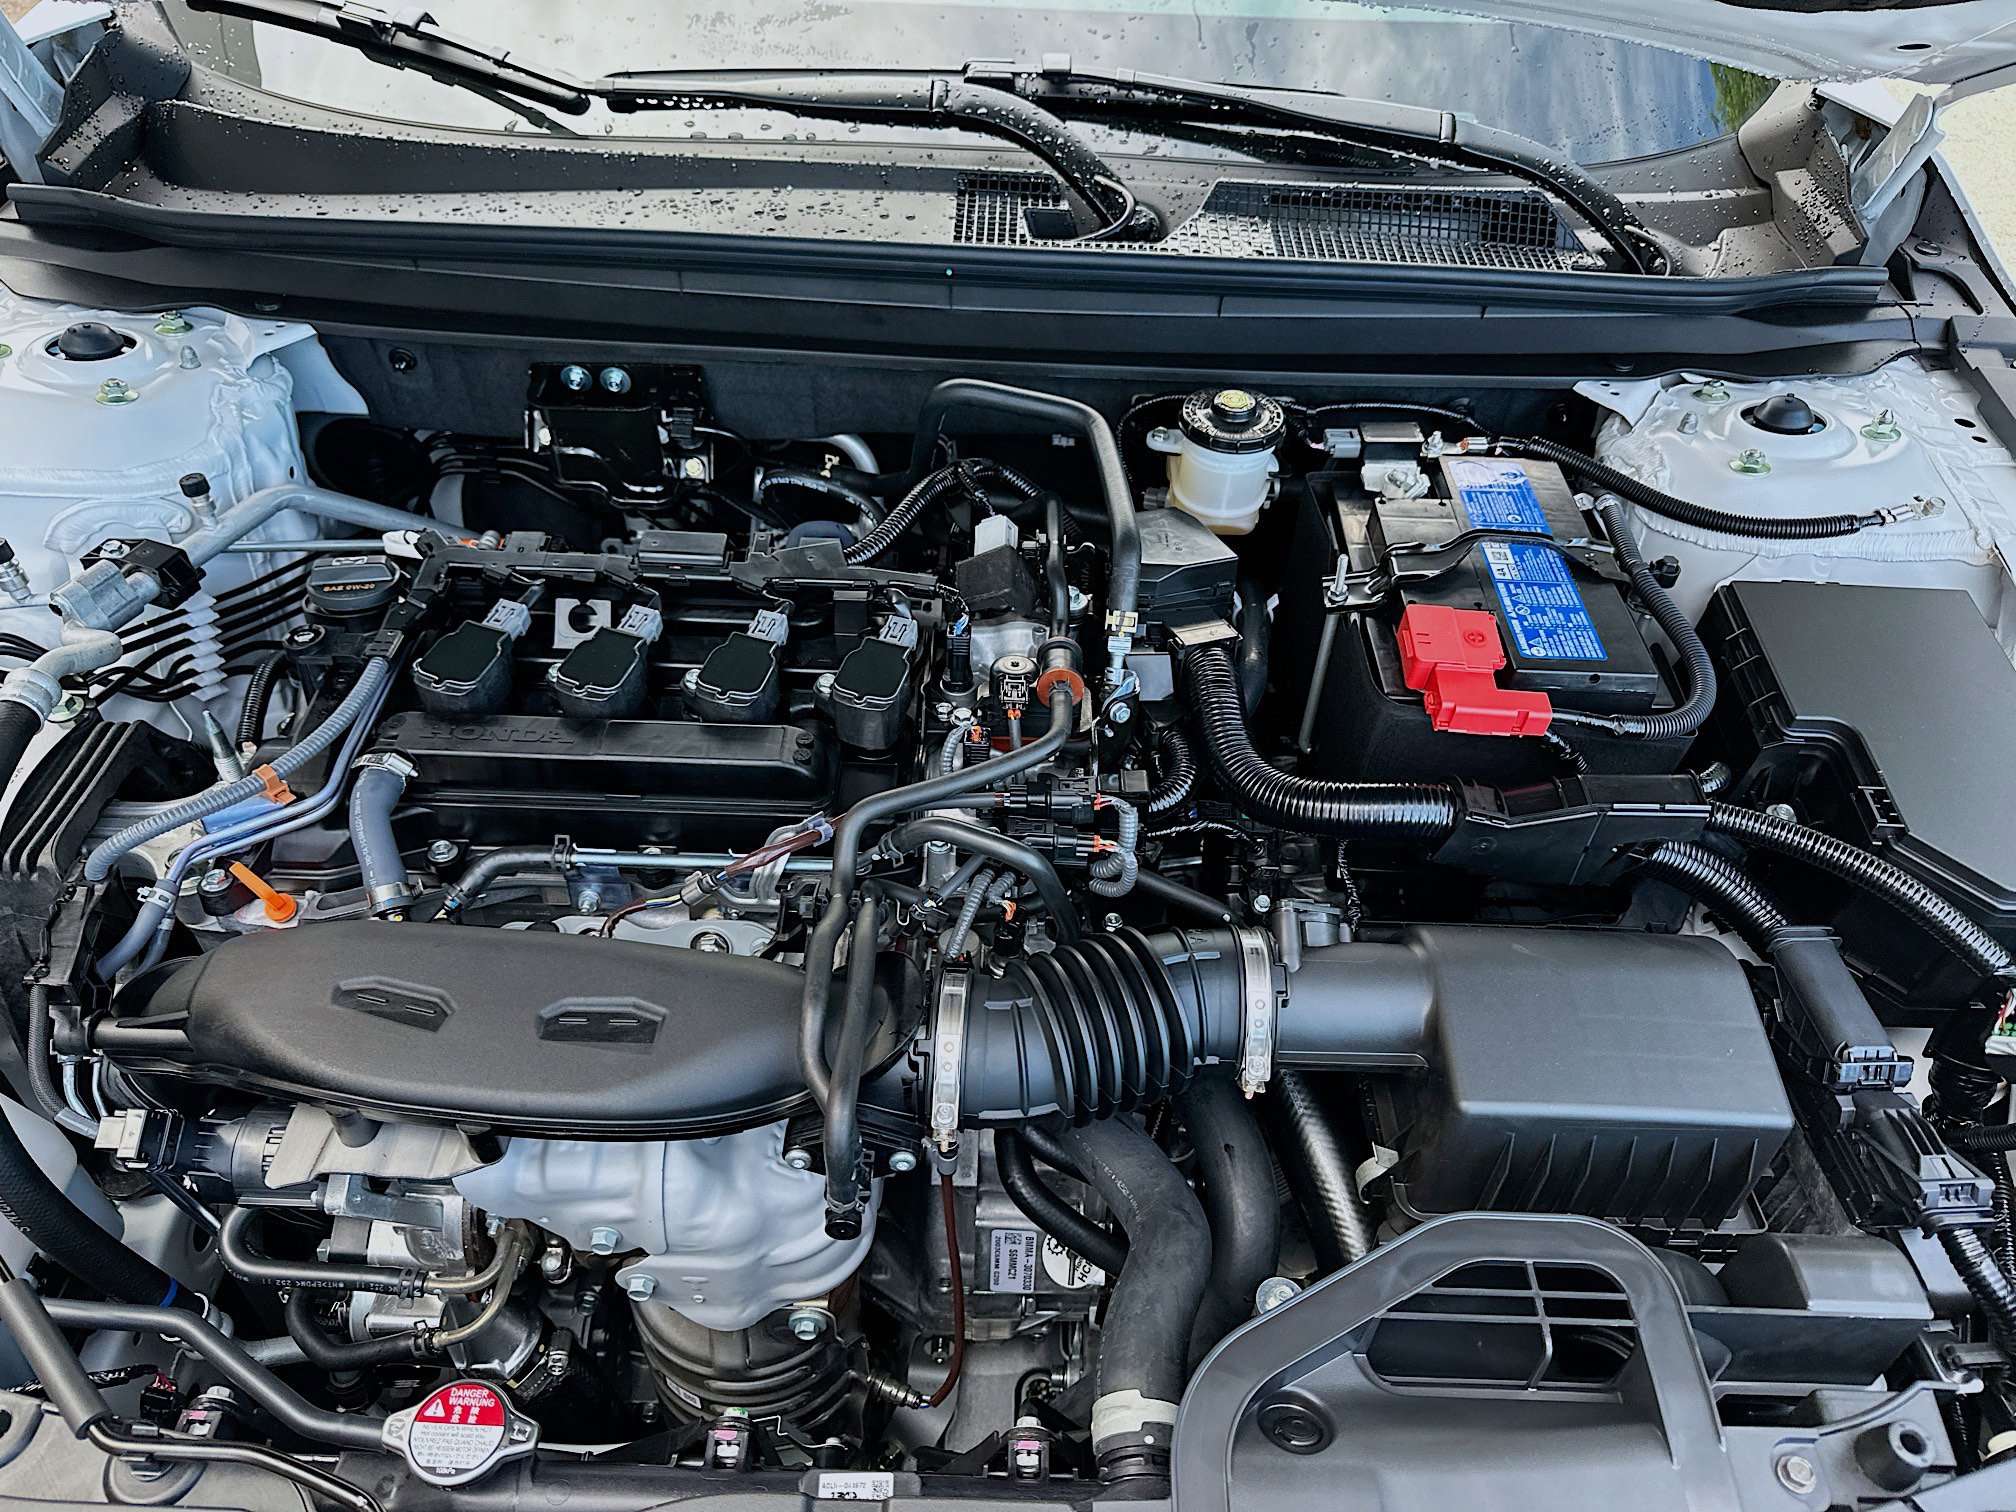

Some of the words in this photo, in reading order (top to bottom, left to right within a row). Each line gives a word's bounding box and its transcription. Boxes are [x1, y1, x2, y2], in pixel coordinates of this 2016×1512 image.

[345, 583, 375, 591] 0W-20
[420, 725, 574, 744] HONDA
[450, 1387, 489, 1398] DANGER
[449, 1396, 496, 1407] WARNUNG
